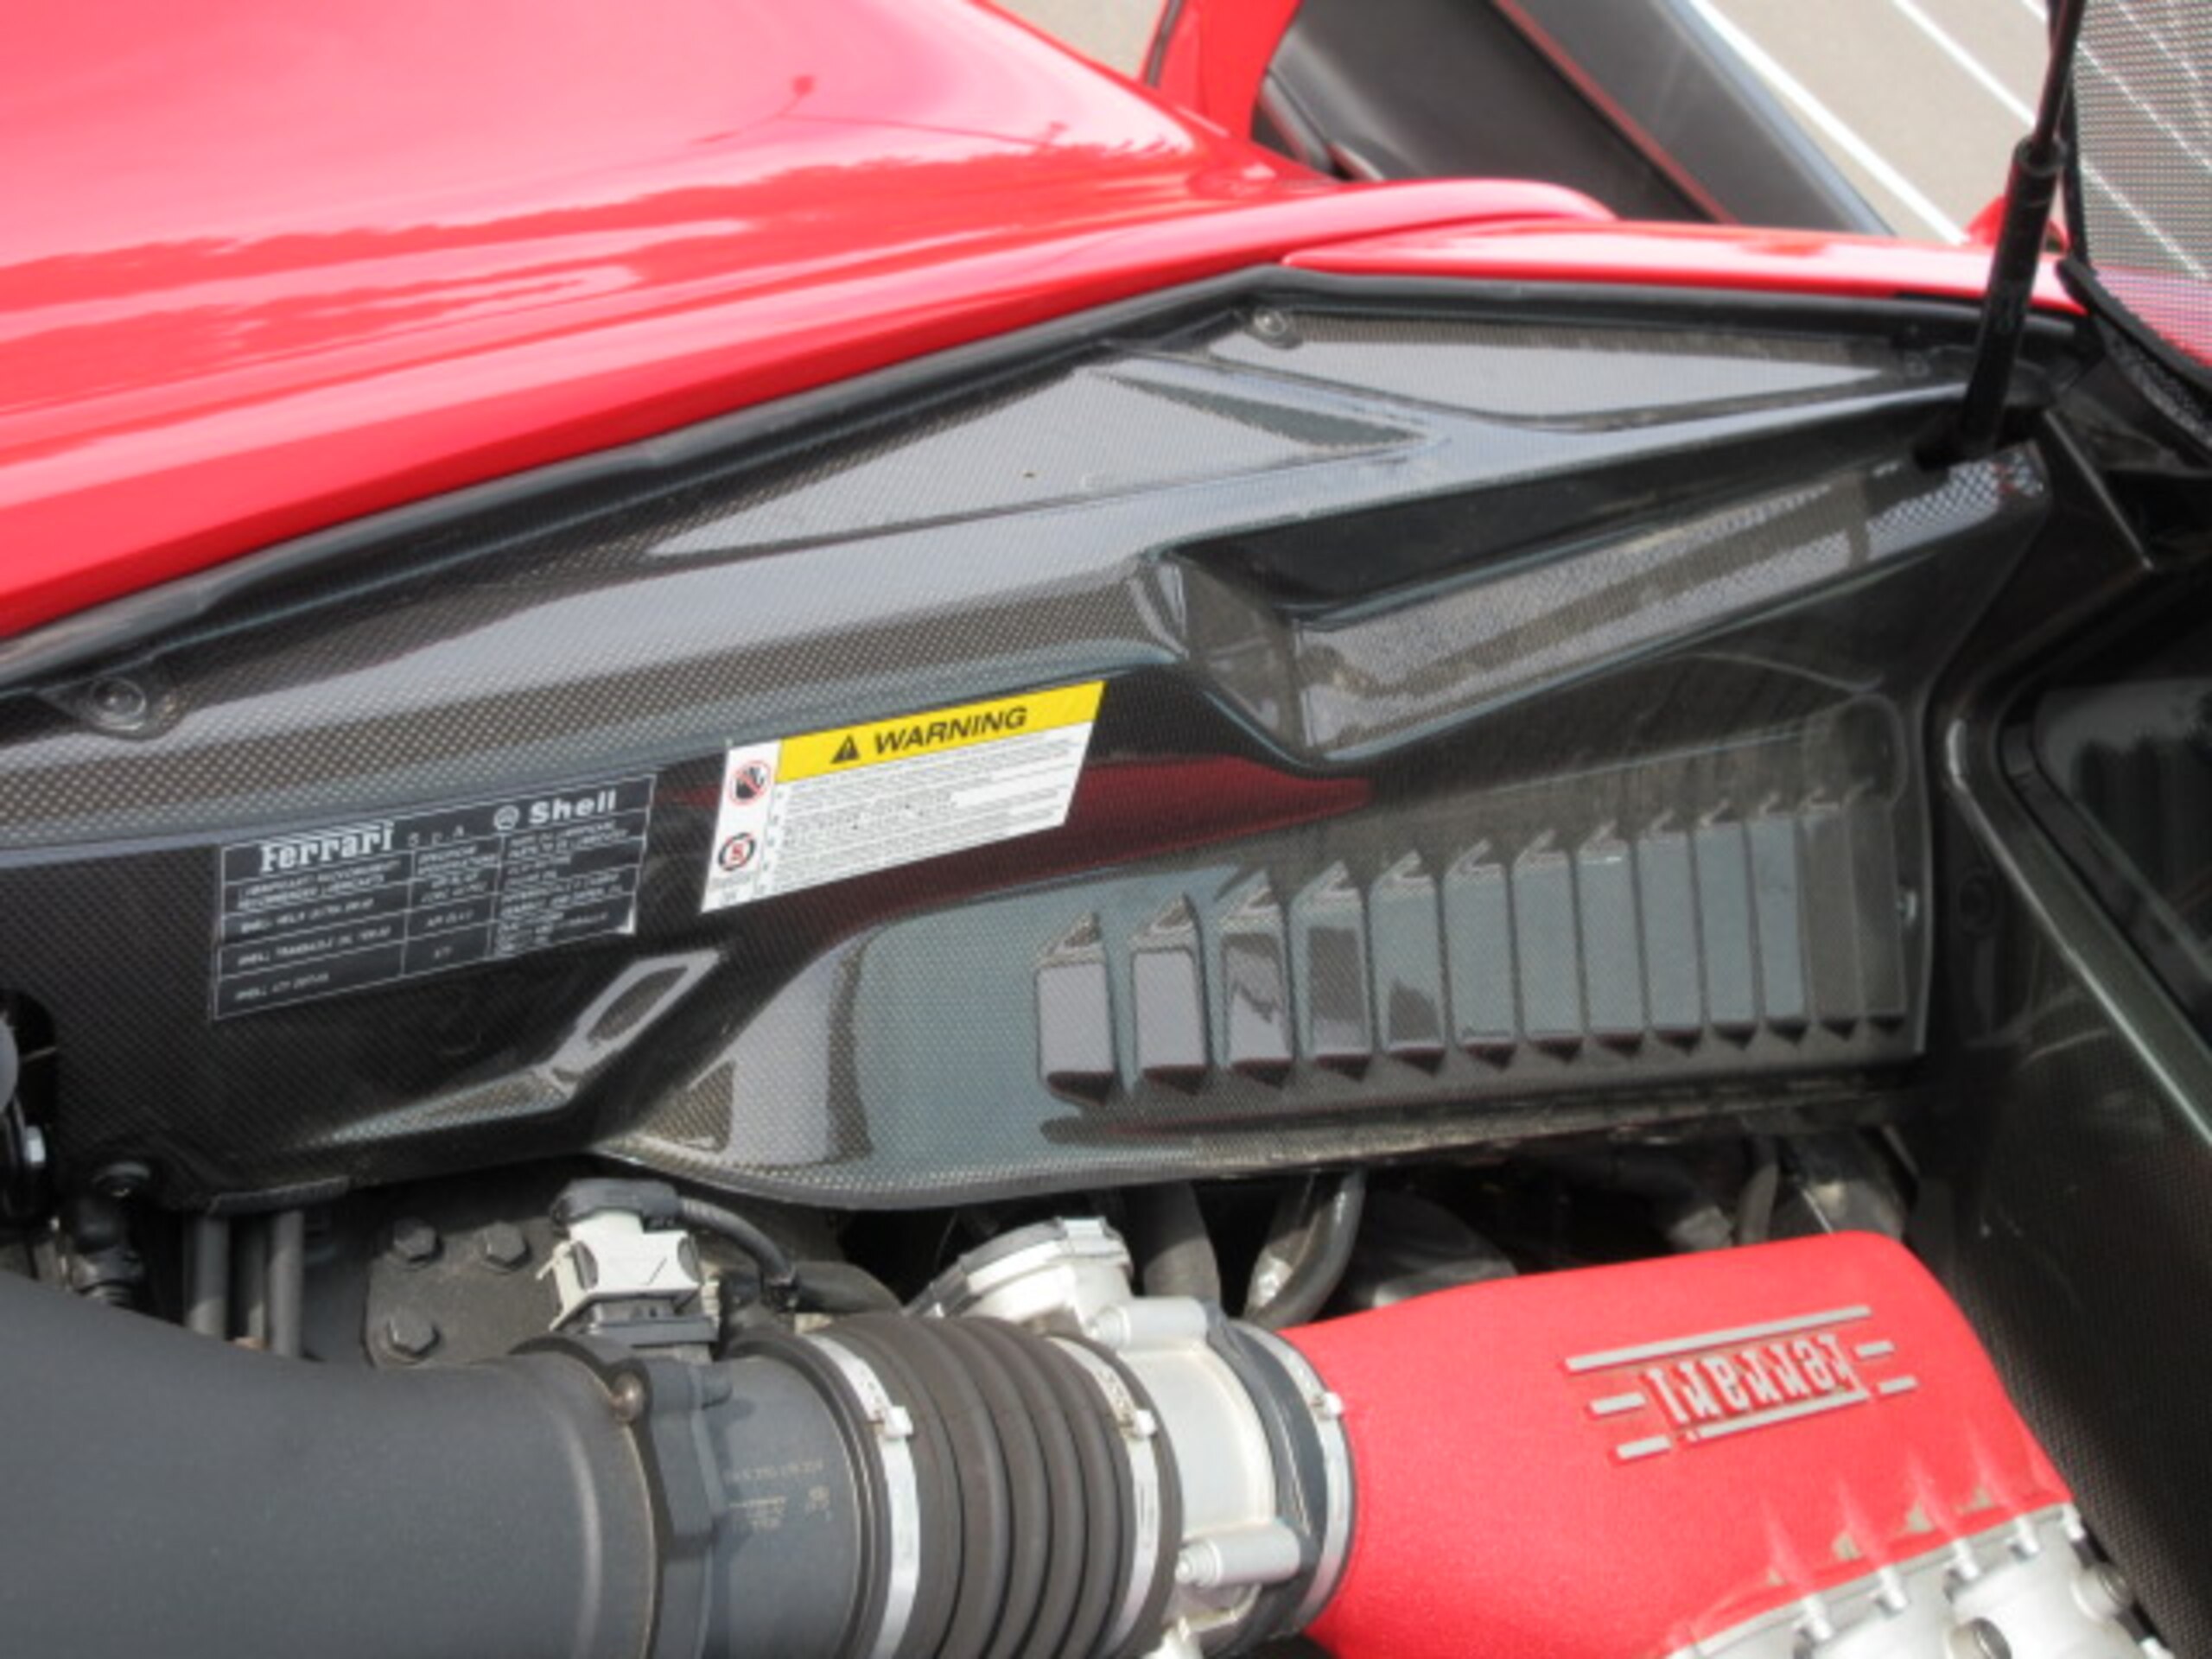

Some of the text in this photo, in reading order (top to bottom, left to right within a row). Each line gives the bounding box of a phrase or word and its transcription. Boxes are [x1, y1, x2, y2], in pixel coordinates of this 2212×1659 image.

[874, 707, 1028, 755] WARNING
[528, 790, 618, 825] Shell
[261, 819, 396, 874] Ferrari
[1647, 1332, 1871, 1440] Ferrari
